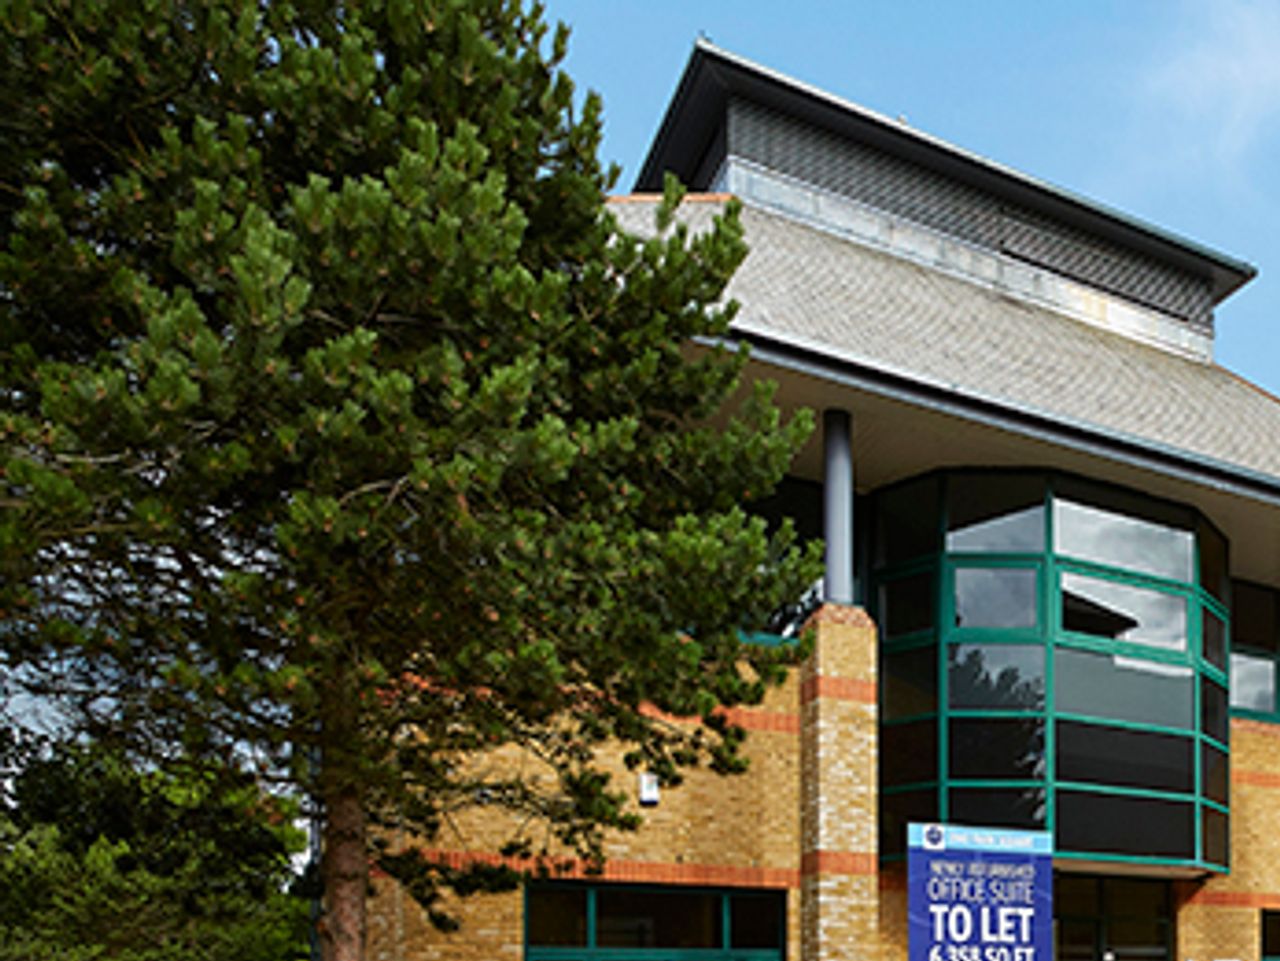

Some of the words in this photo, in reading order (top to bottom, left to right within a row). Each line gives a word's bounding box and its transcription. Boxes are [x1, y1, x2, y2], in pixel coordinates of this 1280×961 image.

[928, 878, 985, 901] OFFICE
[989, 881, 1034, 904] SUITE
[929, 904, 972, 942] TO
[981, 906, 1034, 943] LET
